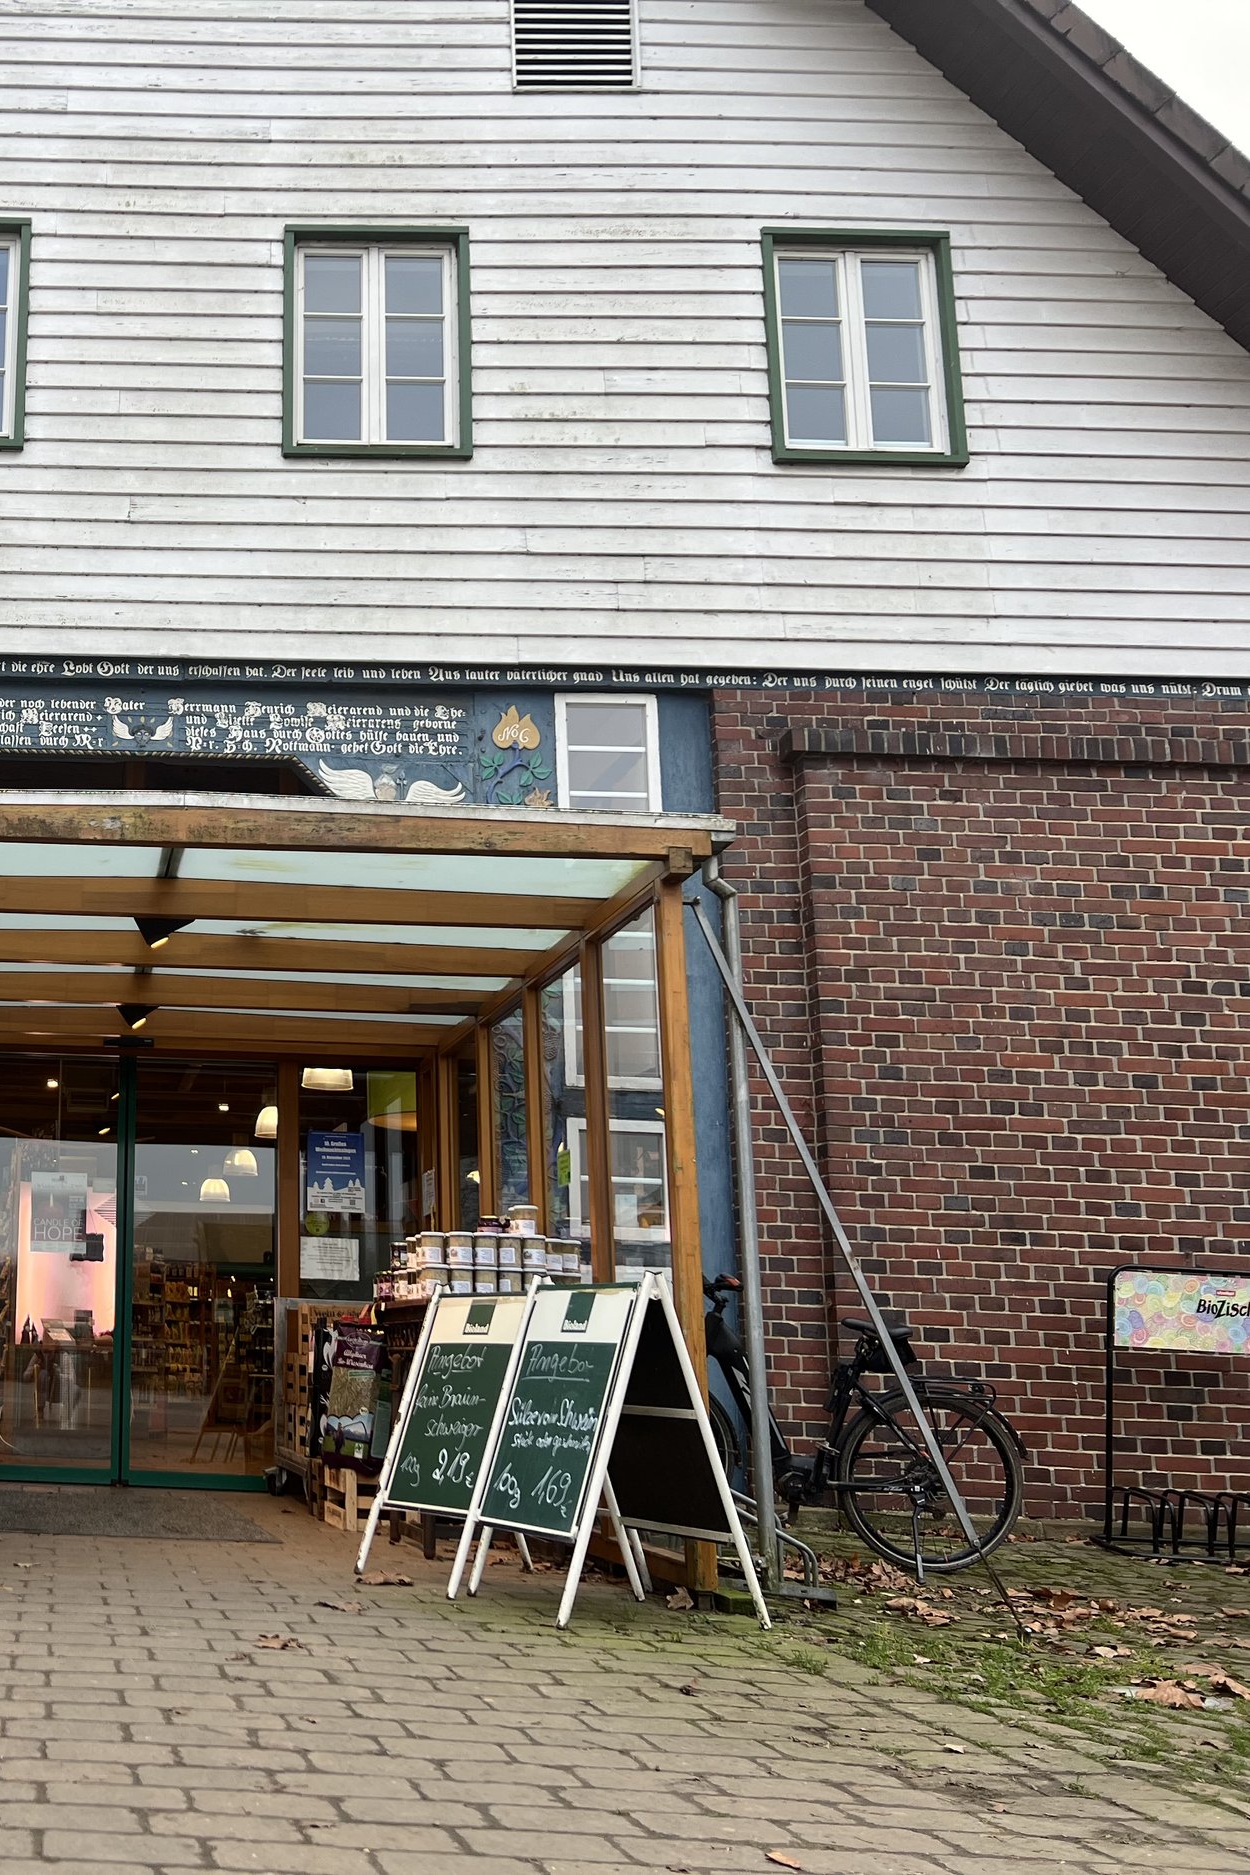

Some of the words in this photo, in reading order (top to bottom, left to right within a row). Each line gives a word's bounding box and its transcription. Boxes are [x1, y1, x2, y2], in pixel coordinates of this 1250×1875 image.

[11, 661, 27, 672] die
[61, 660, 93, 676] Lobt
[97, 660, 129, 676] Gott
[137, 663, 154, 674] der
[158, 664, 179, 676] uns
[271, 664, 296, 678] Der
[333, 667, 354, 678] leib
[362, 668, 386, 679] und
[391, 668, 421, 679] leben
[429, 666, 460, 681] Aus
[465, 669, 500, 680] lauter
[612, 670, 640, 683] Uns
[645, 672, 675, 683] allen
[680, 673, 699, 686] hat
[762, 672, 788, 687] Der
[793, 676, 817, 687] uns
[825, 676, 856, 690] durch
[902, 678, 933, 690] engel
[984, 676, 1010, 691] Der
[1131, 682, 1155, 693] uns
[1201, 682, 1242, 696] Drum
[0, 698, 15, 708] der
[20, 699, 45, 709] noch
[389, 706, 411, 716] und
[414, 706, 429, 716] die
[186, 714, 207, 725] und
[273, 728, 302, 740] durch
[305, 727, 352, 743] Gottes
[437, 732, 459, 743] und
[39, 736, 69, 748] durch
[370, 740, 403, 755] Gott
[409, 742, 424, 754] die
[34, 1218, 68, 1226] CANDLE
[35, 1226, 82, 1241] HOPE
[465, 1323, 489, 1332] Bioland
[563, 1319, 587, 1330] Bioland
[427, 1344, 487, 1379] Angebot
[493, 1462, 520, 1509] 100g
